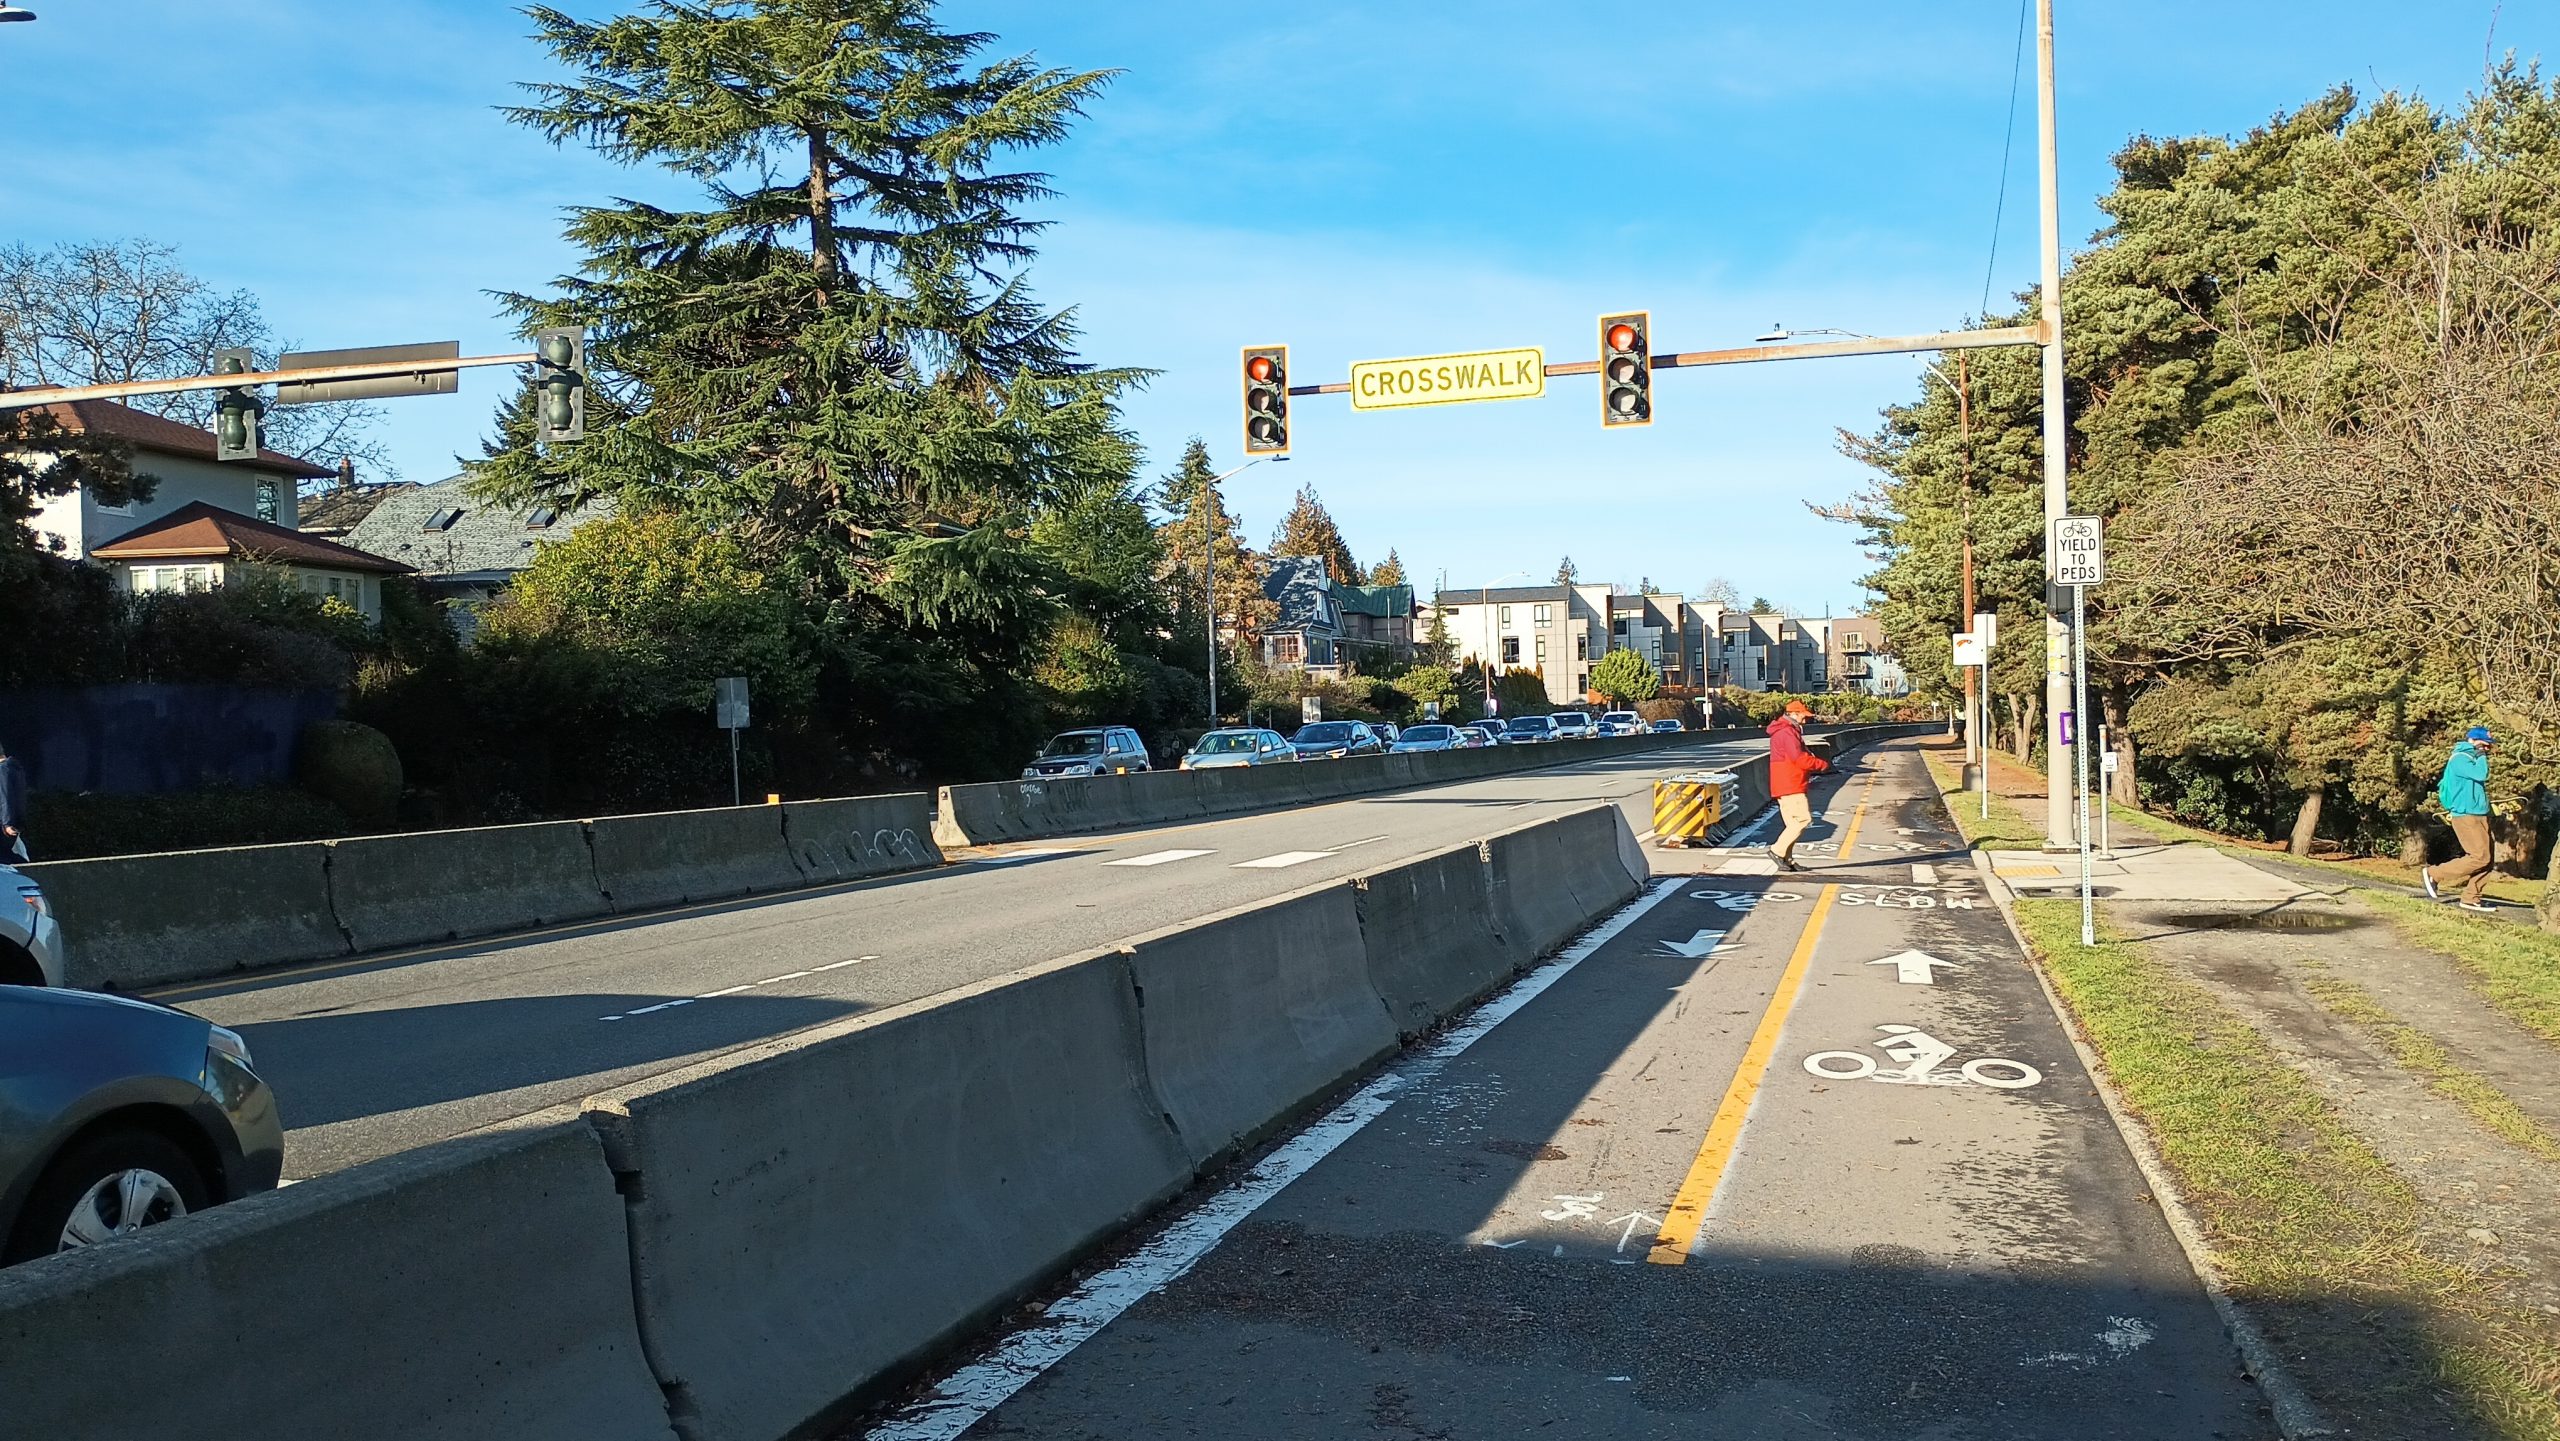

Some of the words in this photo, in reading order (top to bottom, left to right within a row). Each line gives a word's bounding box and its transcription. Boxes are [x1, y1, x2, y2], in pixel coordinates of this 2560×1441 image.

[1361, 360, 1533, 396] CROSSWALK
[2060, 538, 2096, 551] YIELD
[2071, 553, 2086, 565] TO
[2061, 566, 2096, 580] PEDS
[1746, 841, 1840, 852] SLW
[1839, 890, 1974, 911] SLOW
